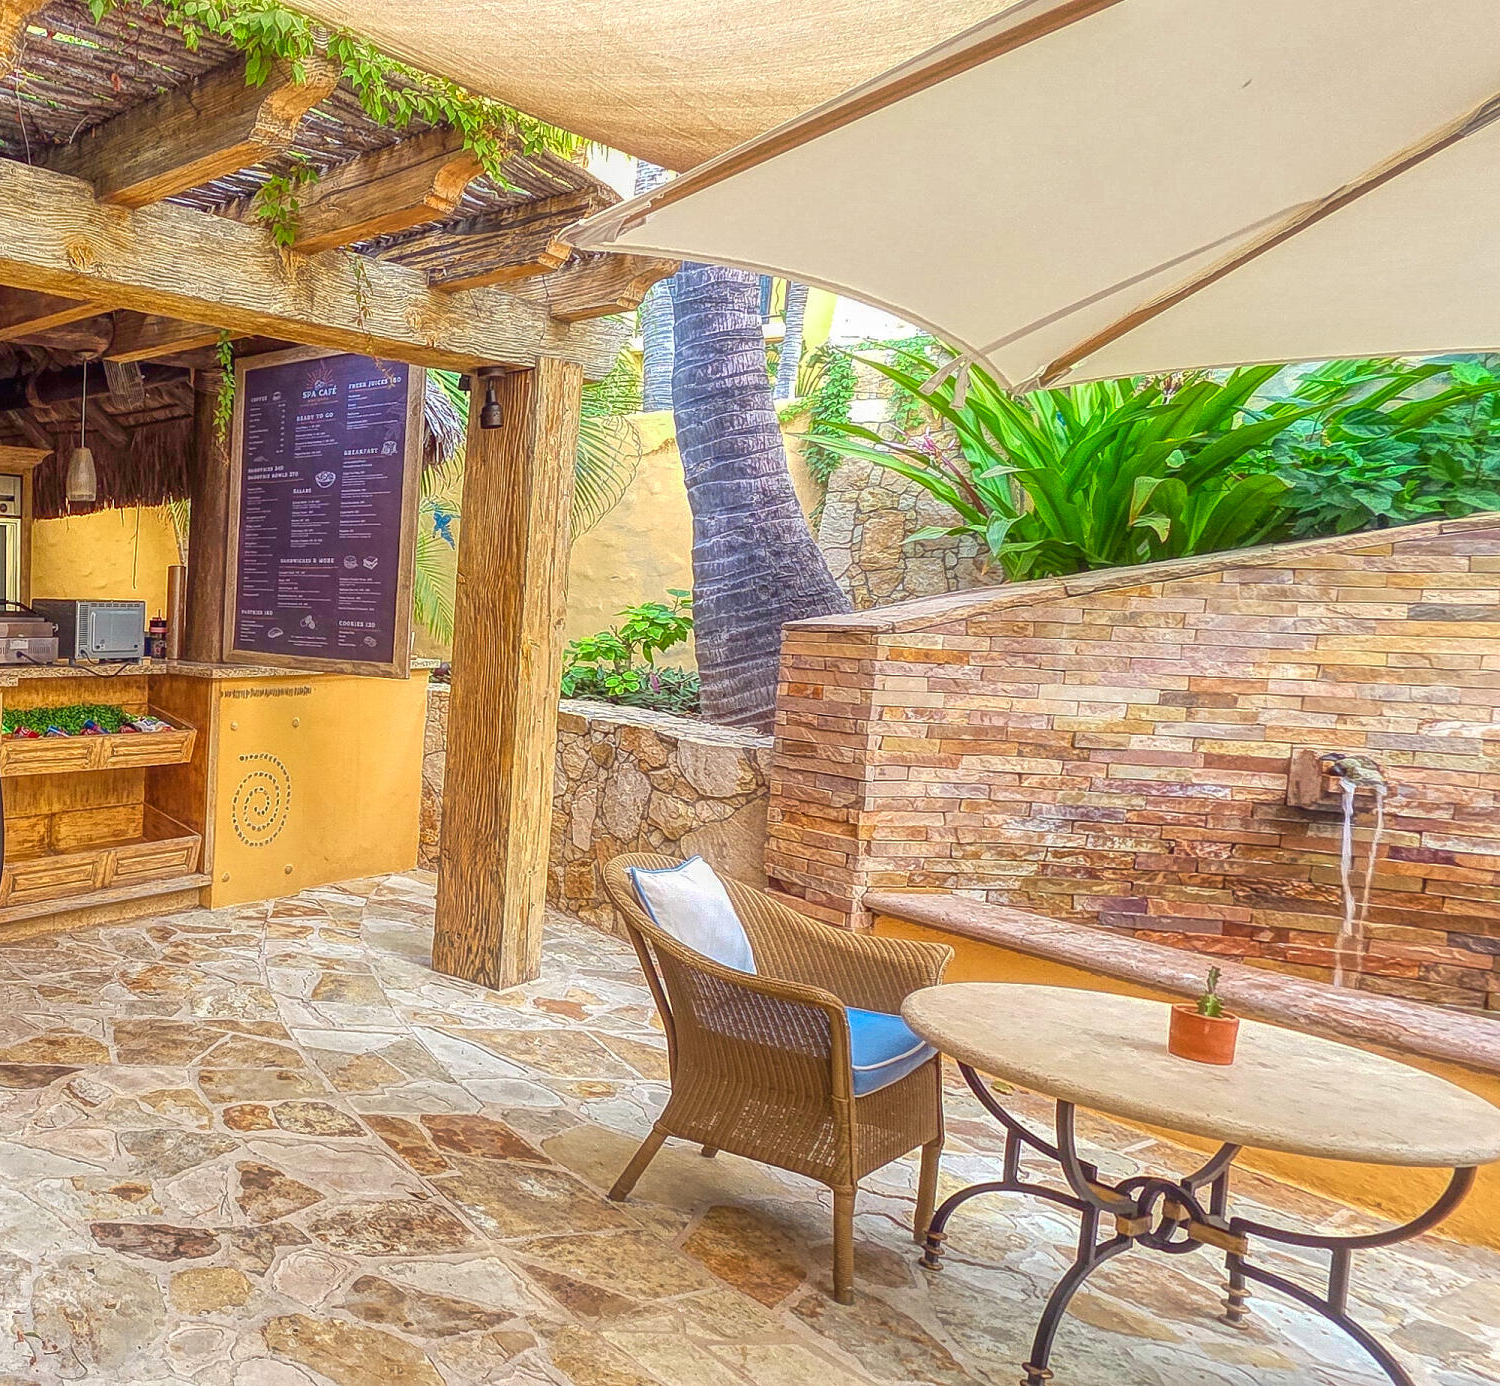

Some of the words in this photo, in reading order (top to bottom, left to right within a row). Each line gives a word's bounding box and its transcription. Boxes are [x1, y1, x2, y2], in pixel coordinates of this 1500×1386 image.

[302, 390, 316, 399] SPA
[318, 385, 338, 397] CAFÉ
[343, 448, 378, 456] BREAKFAST
[338, 620, 364, 628] COOKIES
